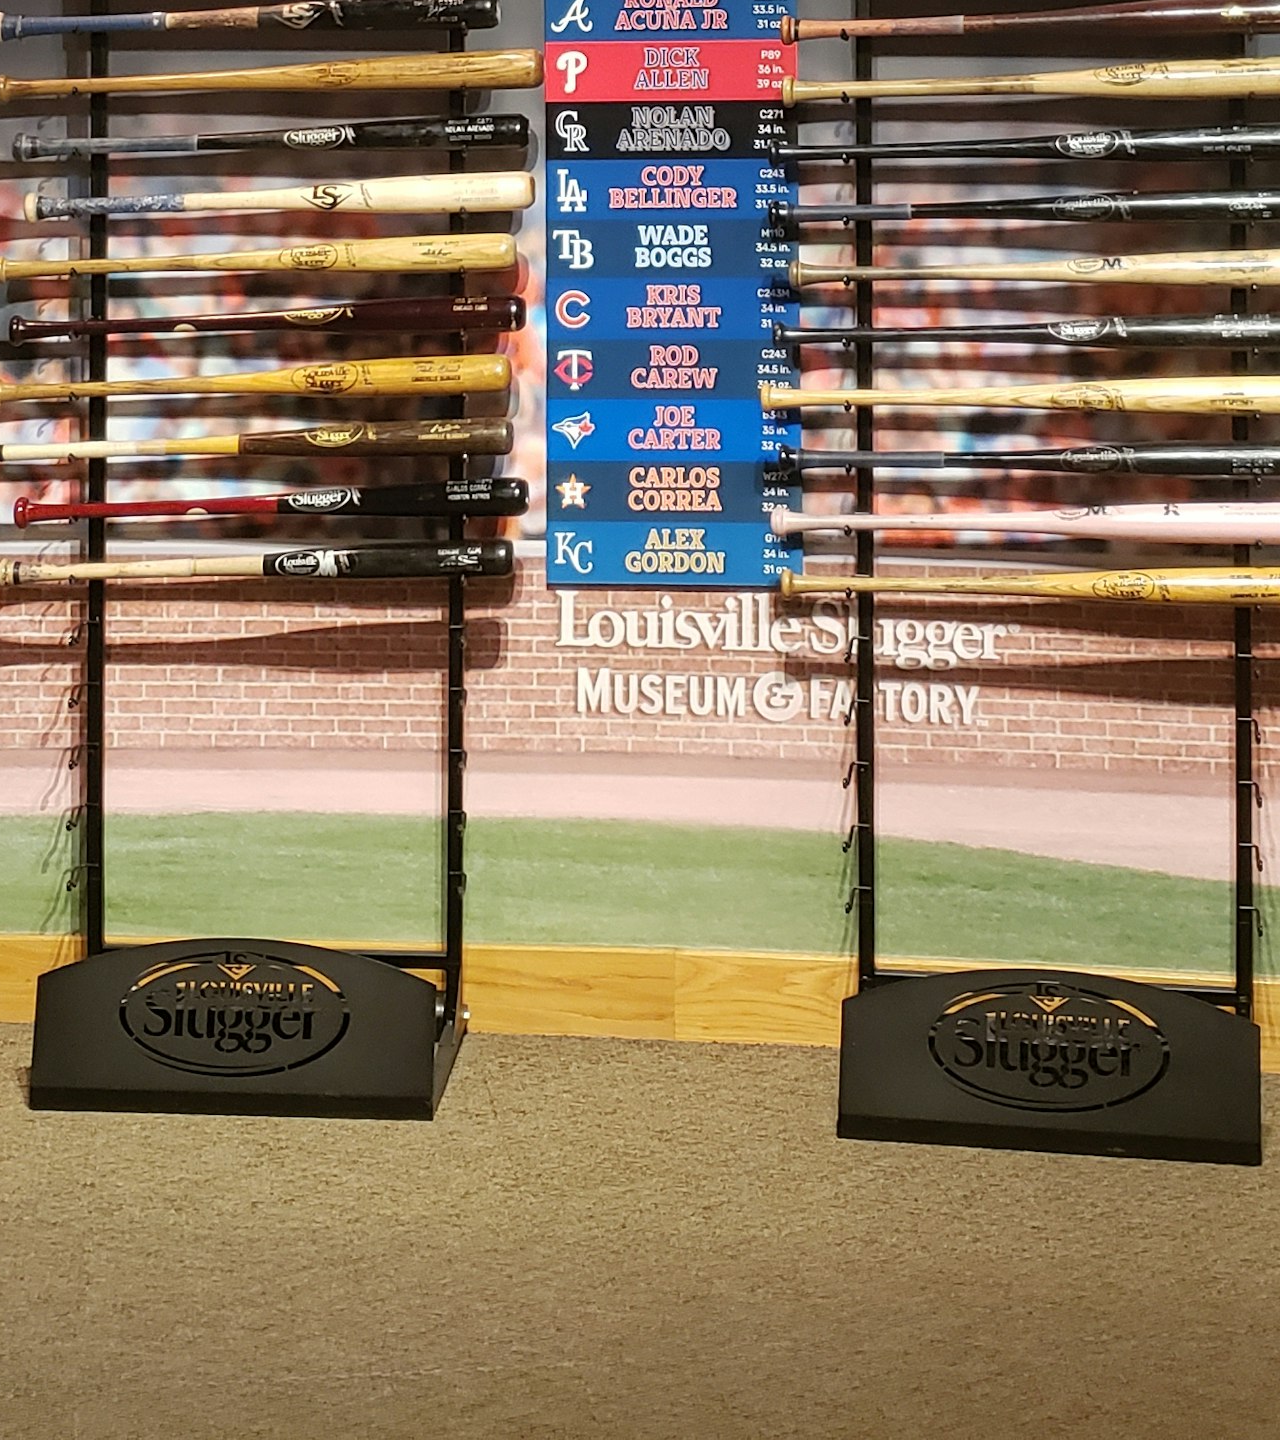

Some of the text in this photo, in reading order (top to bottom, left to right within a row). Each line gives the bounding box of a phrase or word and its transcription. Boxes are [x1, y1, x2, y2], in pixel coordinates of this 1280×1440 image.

[753, 5, 773, 14] 33.5
[614, 10, 728, 30] ACUNA JR
[644, 47, 700, 67] DICK
[761, 50, 781, 59] P89
[634, 68, 709, 90] ALLEN
[758, 65, 770, 74] 36
[632, 106, 715, 129] NOLAN
[760, 110, 784, 119] C271
[616, 128, 730, 151] ARENADO
[641, 166, 704, 186] CODY
[760, 169, 785, 178] C243
[609, 187, 737, 209] BELLINGER
[755, 184, 776, 193] 33.5
[638, 225, 708, 245] WADE
[755, 243, 778, 252] 34.5
[635, 248, 712, 268] BOGGS
[646, 285, 701, 305] KRIS
[626, 308, 721, 328] BRYANT
[649, 345, 698, 366] ROD
[761, 349, 786, 358] C243
[631, 368, 718, 389] CAREW
[653, 406, 695, 426] JOE
[628, 429, 721, 450] CARTER
[629, 467, 720, 488] CARLOS
[628, 490, 722, 511] CORREA
[645, 528, 705, 549] ALEX
[625, 552, 725, 573] GORDON
[555, 589, 801, 653] Louisville
[577, 667, 744, 717] MUSEUM
[811, 678, 979, 725] FATORY
